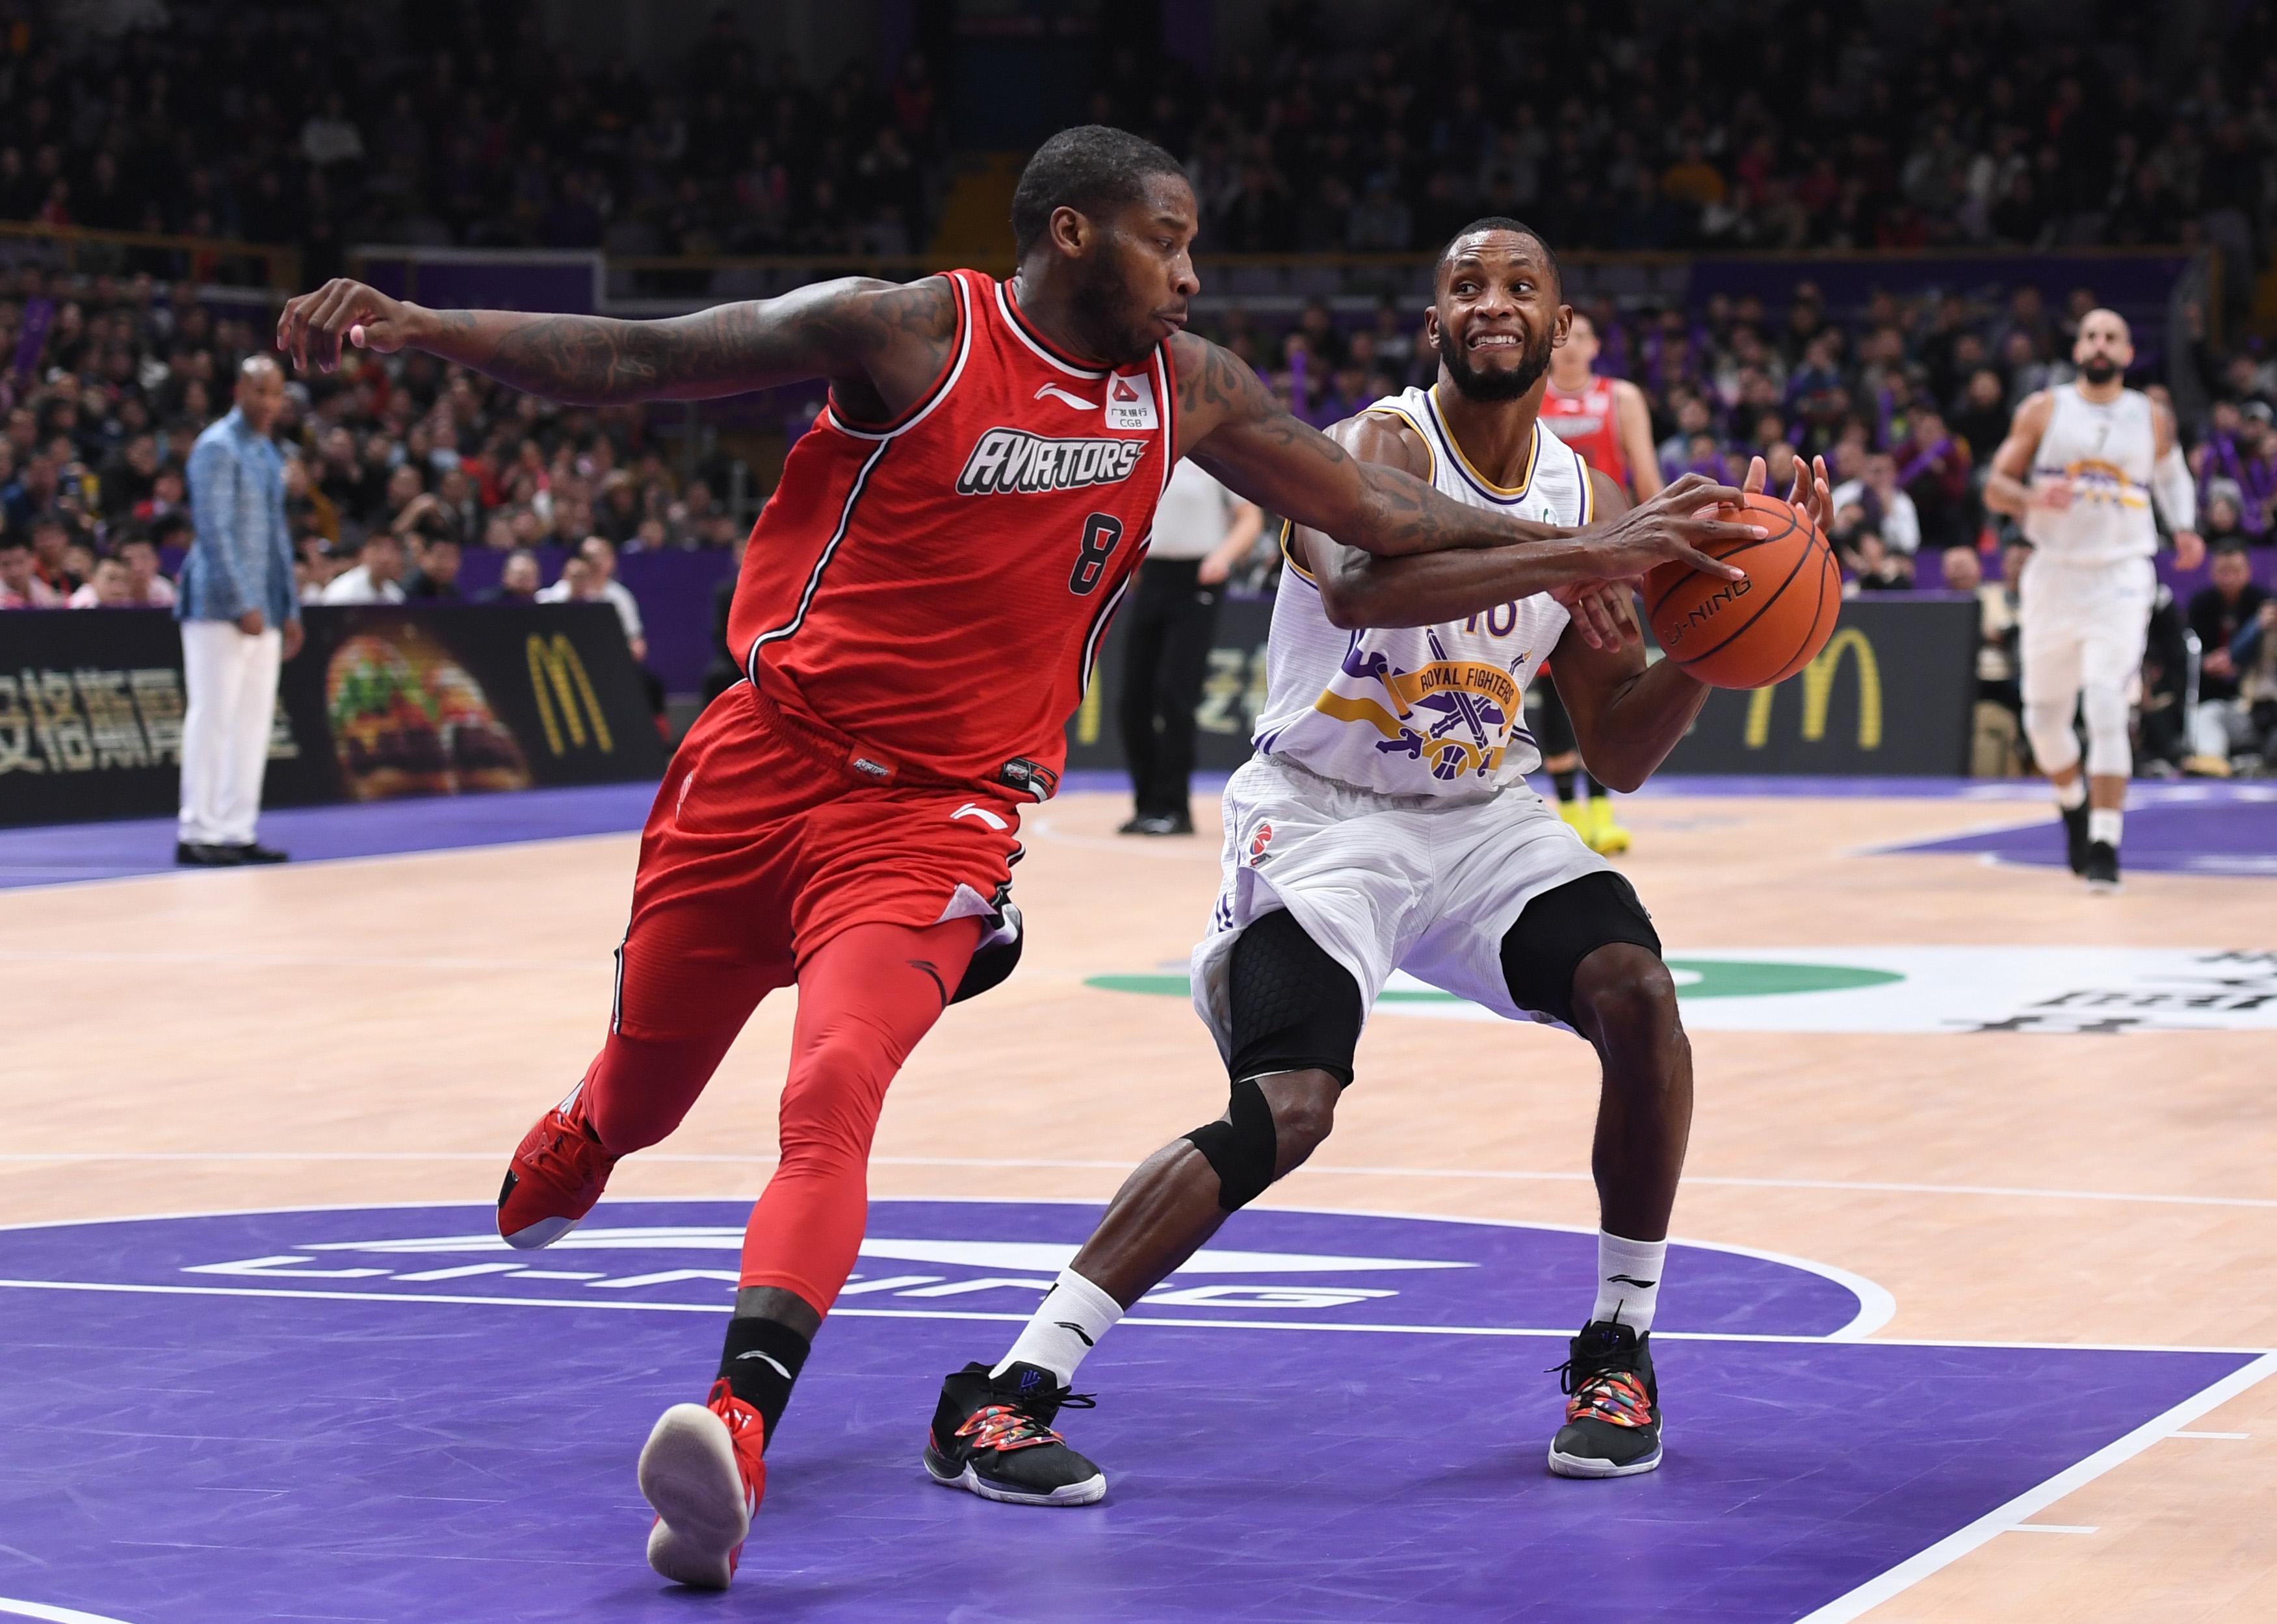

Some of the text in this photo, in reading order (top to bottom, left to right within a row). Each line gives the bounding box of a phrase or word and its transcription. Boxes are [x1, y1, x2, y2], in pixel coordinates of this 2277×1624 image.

[1119, 419, 1143, 428] CGB
[956, 426, 1149, 494] AVIATORS
[1068, 511, 1124, 597] 8
[1420, 667, 1461, 693] ROYAL
[1465, 667, 1515, 705] FIGHTERS
